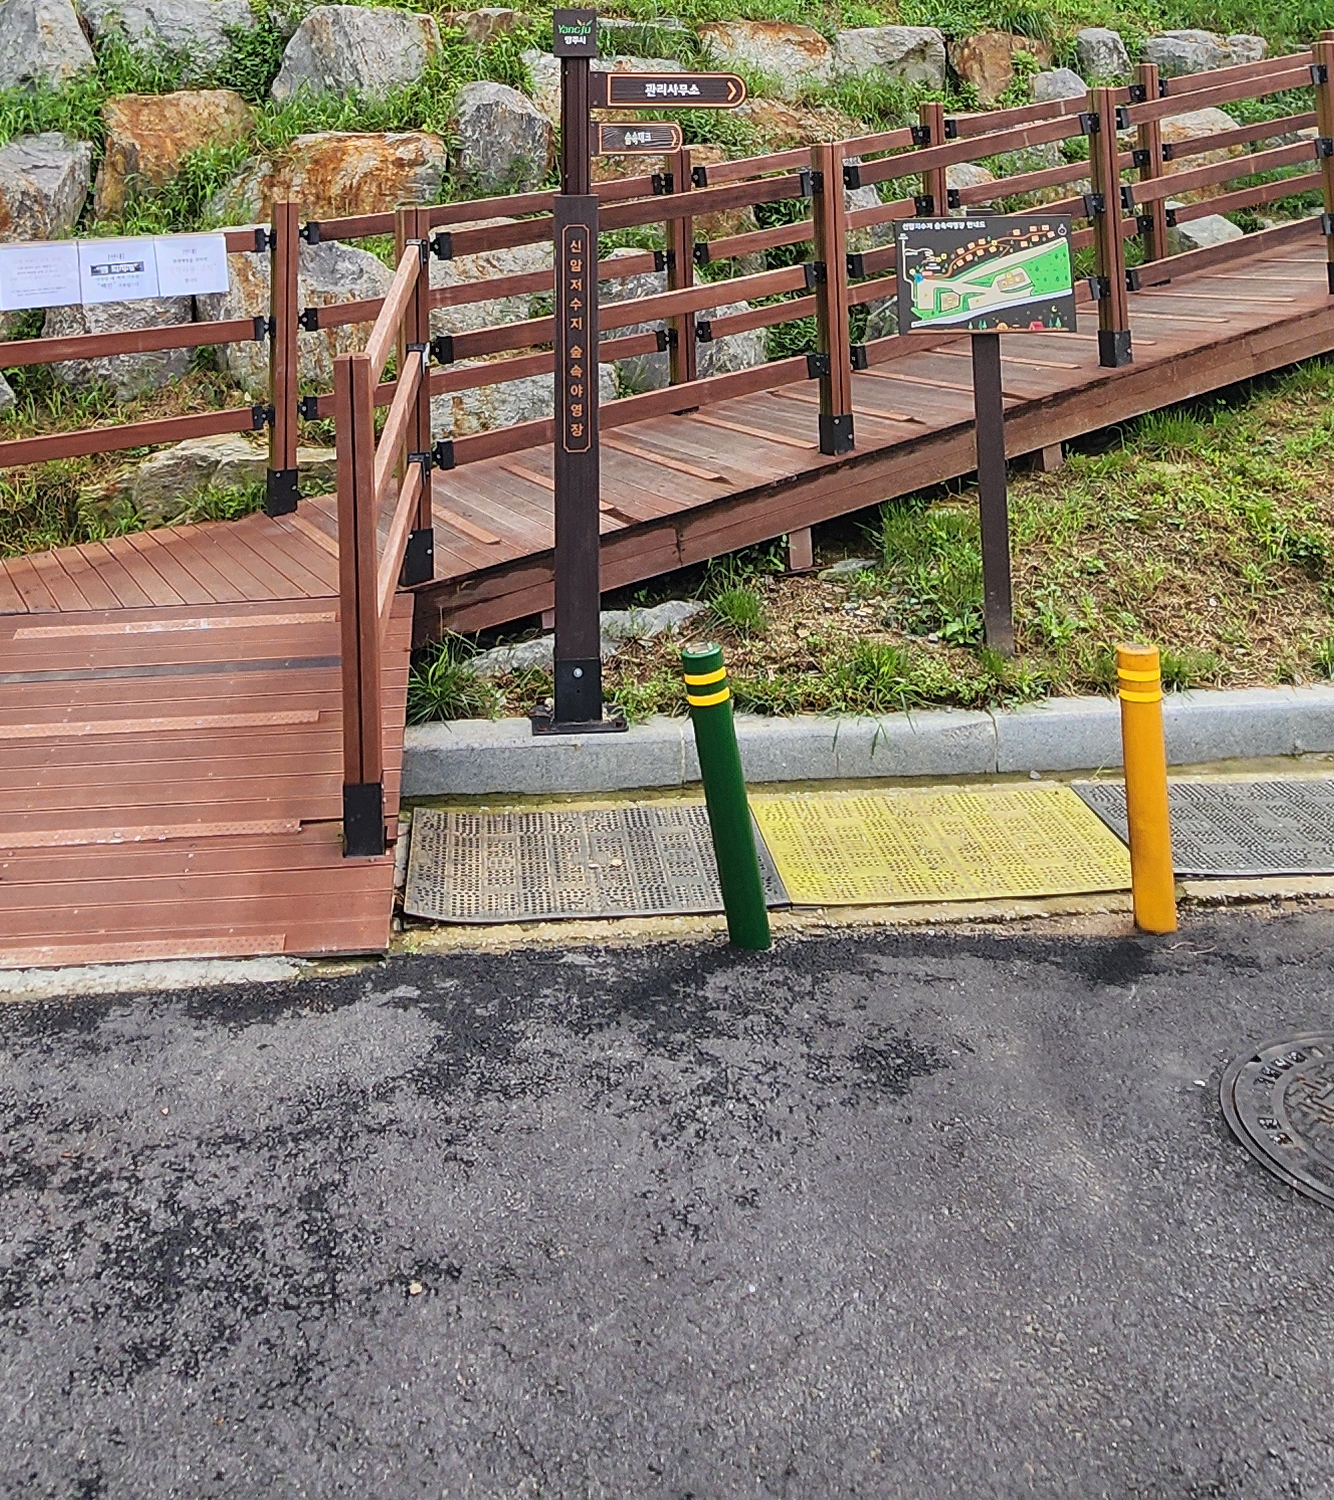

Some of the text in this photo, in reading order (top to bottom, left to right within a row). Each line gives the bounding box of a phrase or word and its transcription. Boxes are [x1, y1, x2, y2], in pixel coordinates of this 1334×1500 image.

[644, 83, 701, 98] 관리사무소
[569, 239, 584, 437] 신암저수지 숲속야영장
